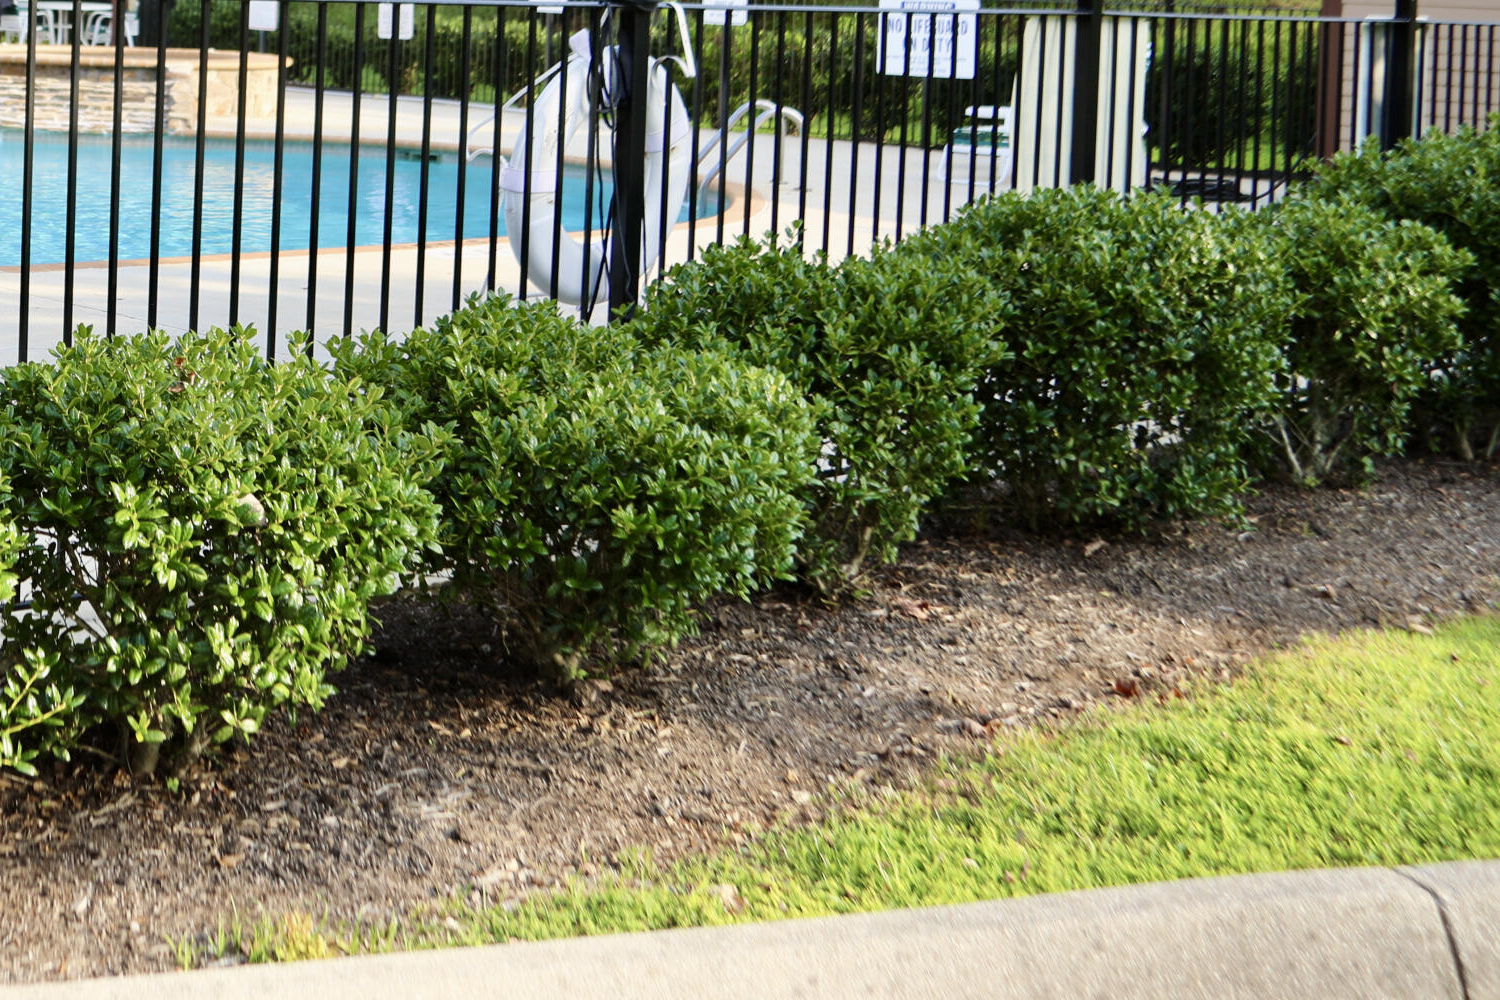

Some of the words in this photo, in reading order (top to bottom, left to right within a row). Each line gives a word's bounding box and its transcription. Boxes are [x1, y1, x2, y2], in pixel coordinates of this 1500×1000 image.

[887, 19, 902, 33] NO
[909, 19, 968, 35] IFEUAD
[922, 38, 952, 53] DTY
